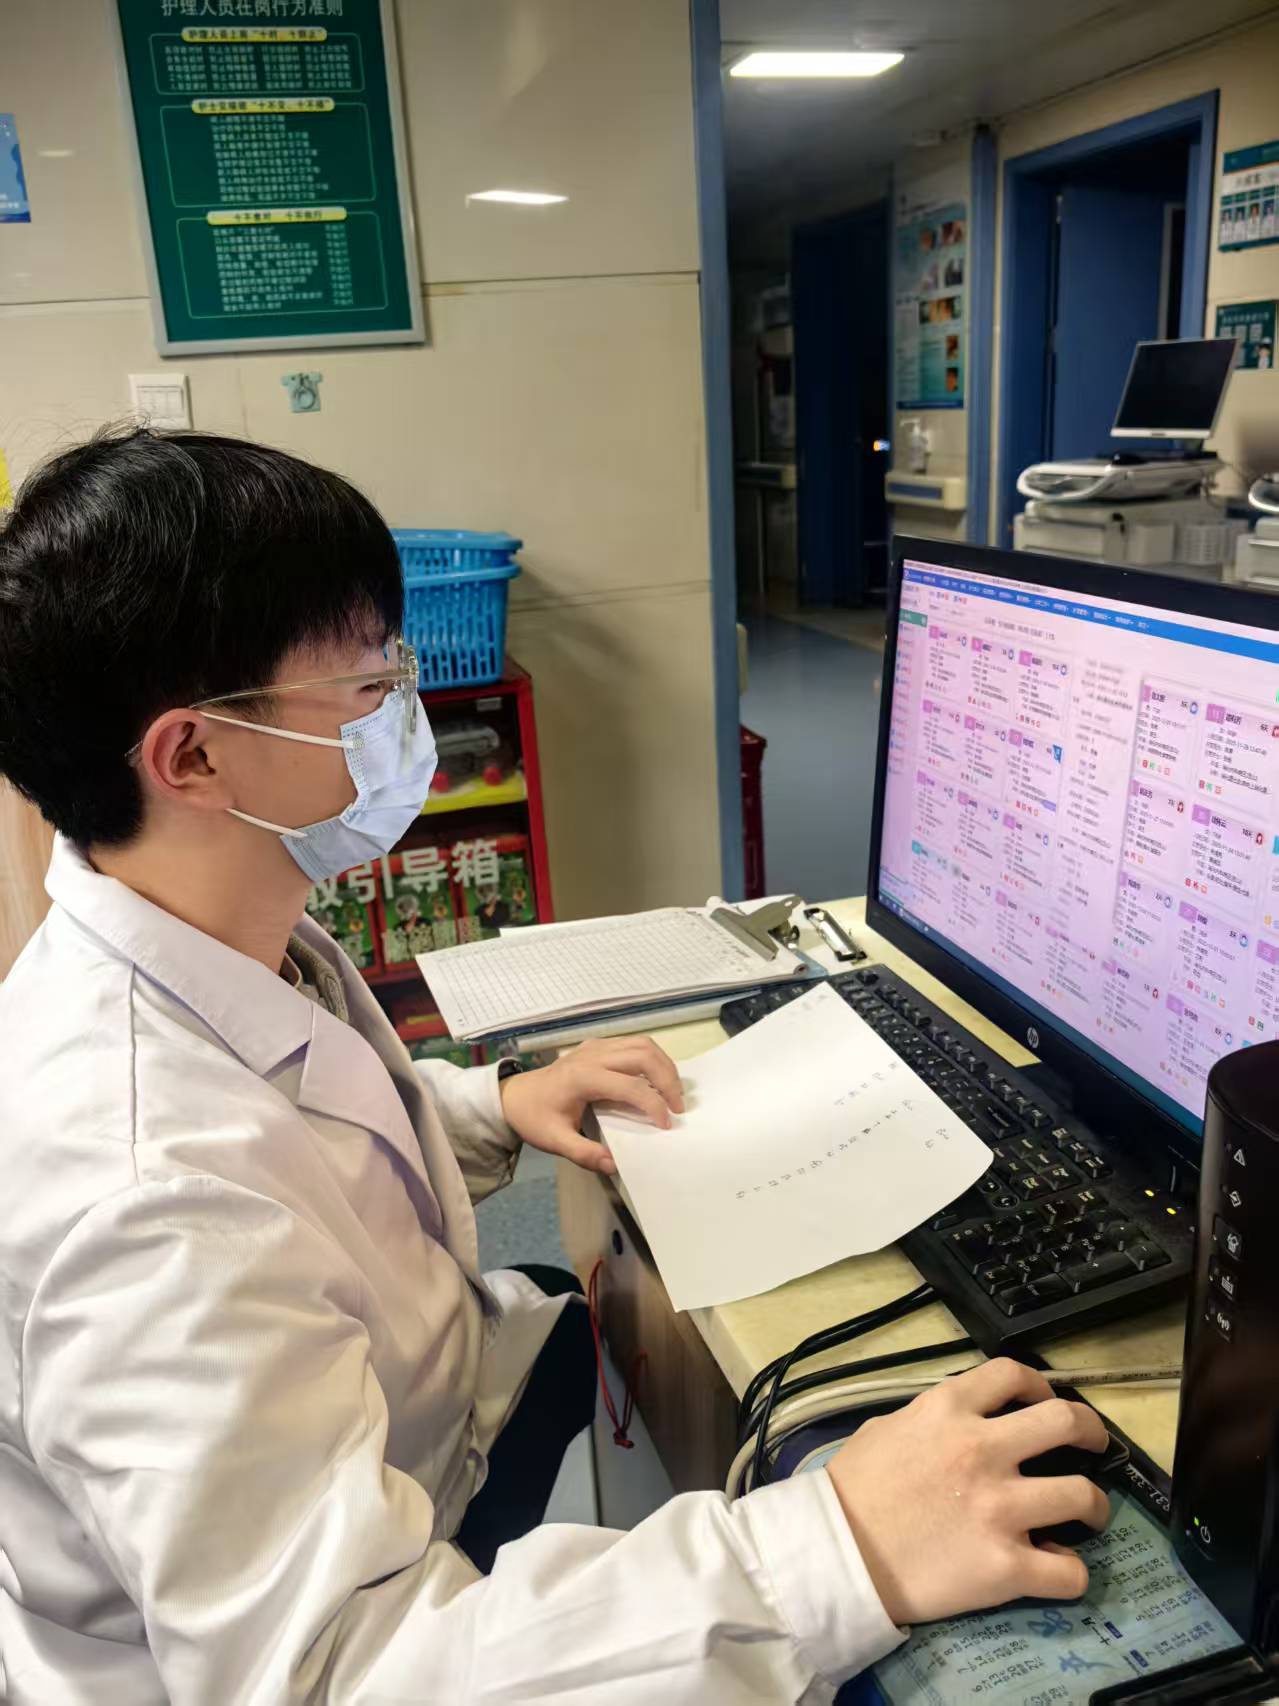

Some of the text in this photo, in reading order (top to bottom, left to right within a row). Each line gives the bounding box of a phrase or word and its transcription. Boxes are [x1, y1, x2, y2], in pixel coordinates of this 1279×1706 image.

[994, 1623, 1008, 1634] 29
[1080, 1615, 1111, 1646] 十一月
[959, 1634, 972, 1648] 15
[992, 1647, 1006, 1658] 21
[974, 1655, 988, 1666] 14
[1023, 1659, 1039, 1670] 27
[1006, 1665, 1021, 1677] 20
[988, 1672, 1002, 1685] 13
